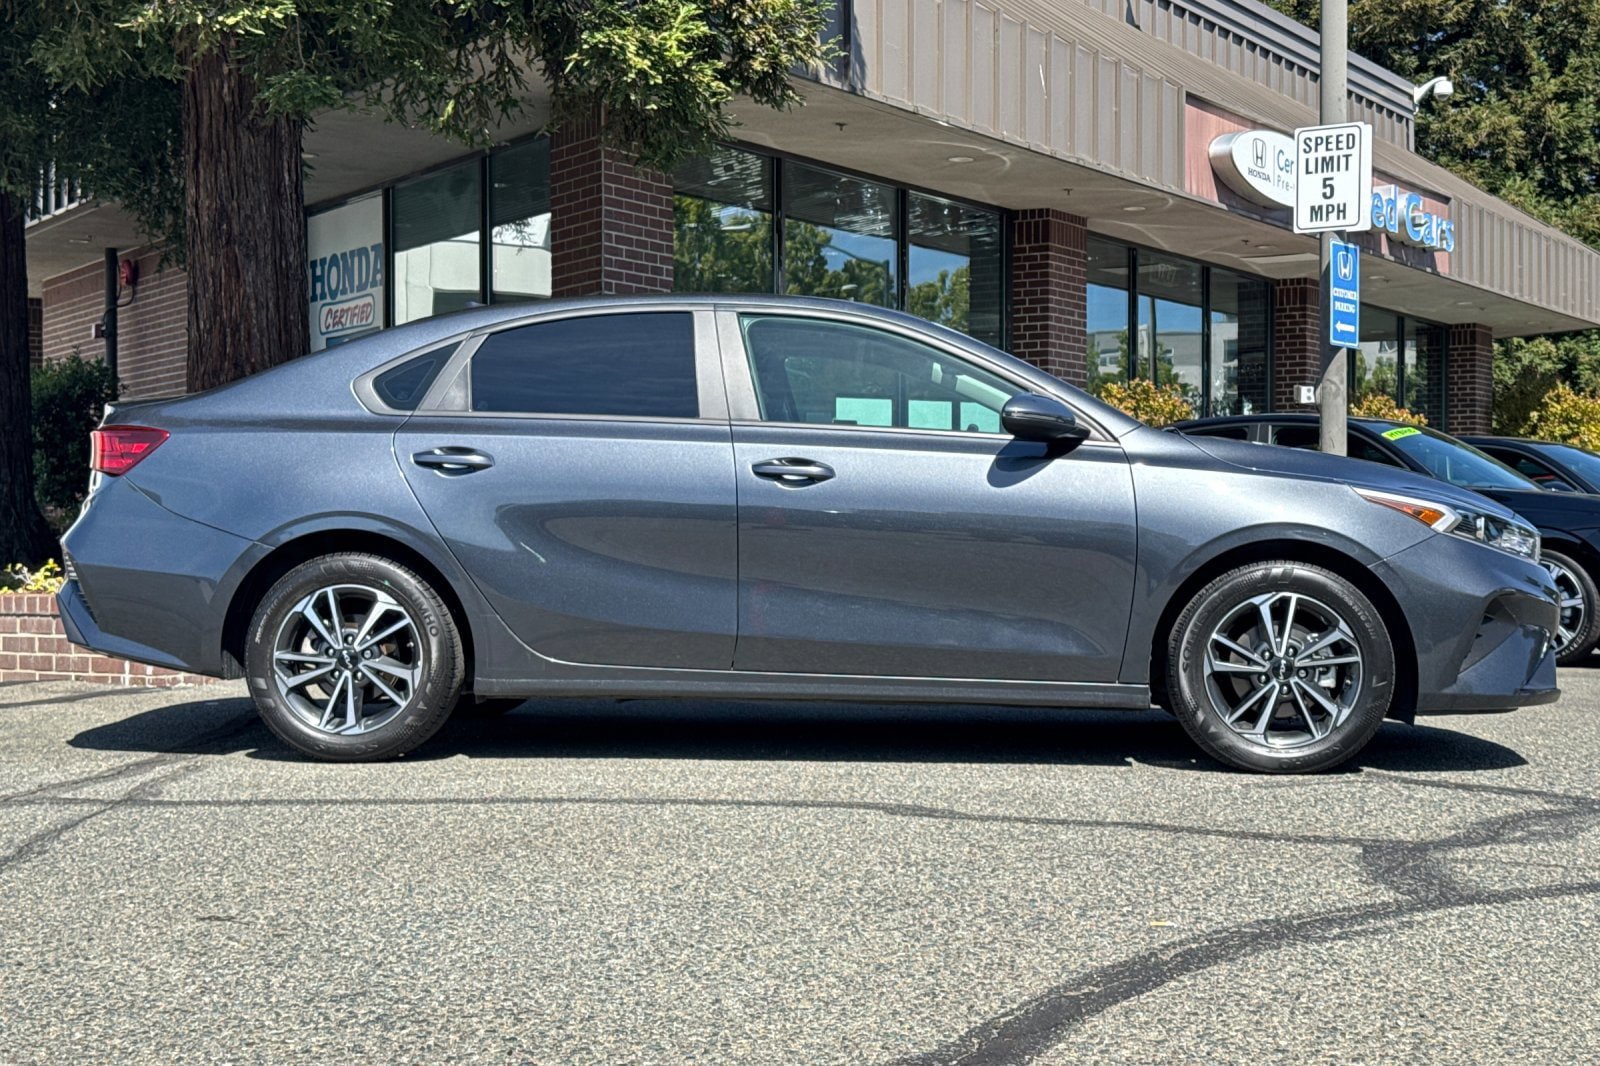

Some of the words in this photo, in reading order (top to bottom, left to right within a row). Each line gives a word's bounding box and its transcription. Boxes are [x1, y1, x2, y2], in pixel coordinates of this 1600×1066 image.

[1303, 133, 1356, 154] SPEED
[1248, 167, 1271, 183] HONDA
[1305, 154, 1353, 175] LIMIT
[1322, 177, 1335, 200] 5
[1310, 202, 1347, 223] MPH
[1405, 192, 1455, 252] Cars
[310, 243, 383, 303] HONDA
[324, 302, 373, 330] CERTIFIED
